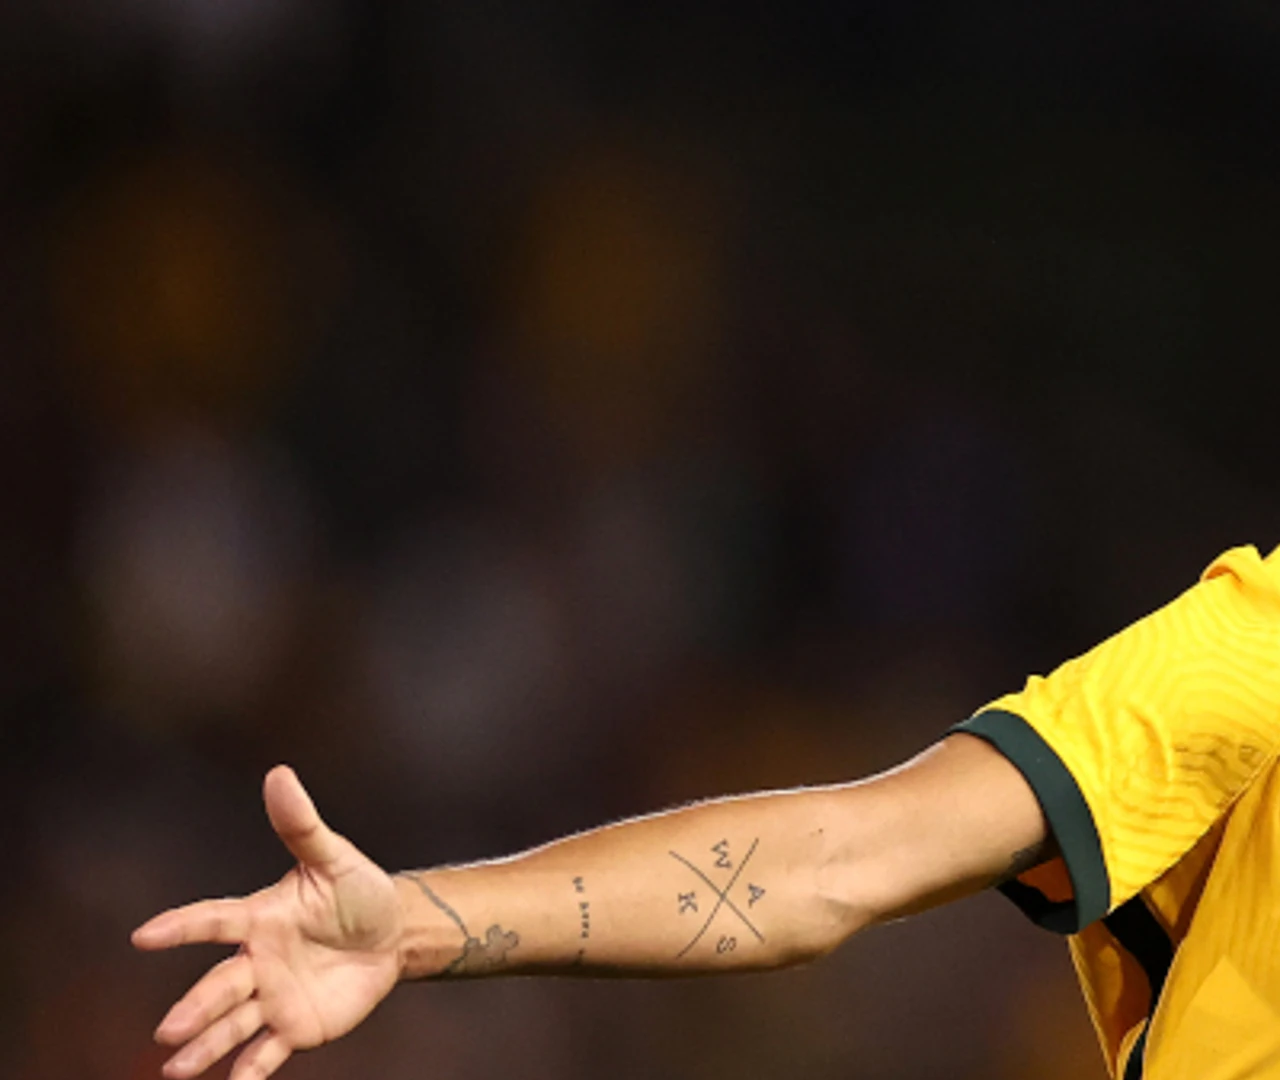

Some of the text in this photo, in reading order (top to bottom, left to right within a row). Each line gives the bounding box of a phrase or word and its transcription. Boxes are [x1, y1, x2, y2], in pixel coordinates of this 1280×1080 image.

[710, 839, 732, 869] W
[678, 891, 699, 914] K
[748, 883, 766, 909] A
